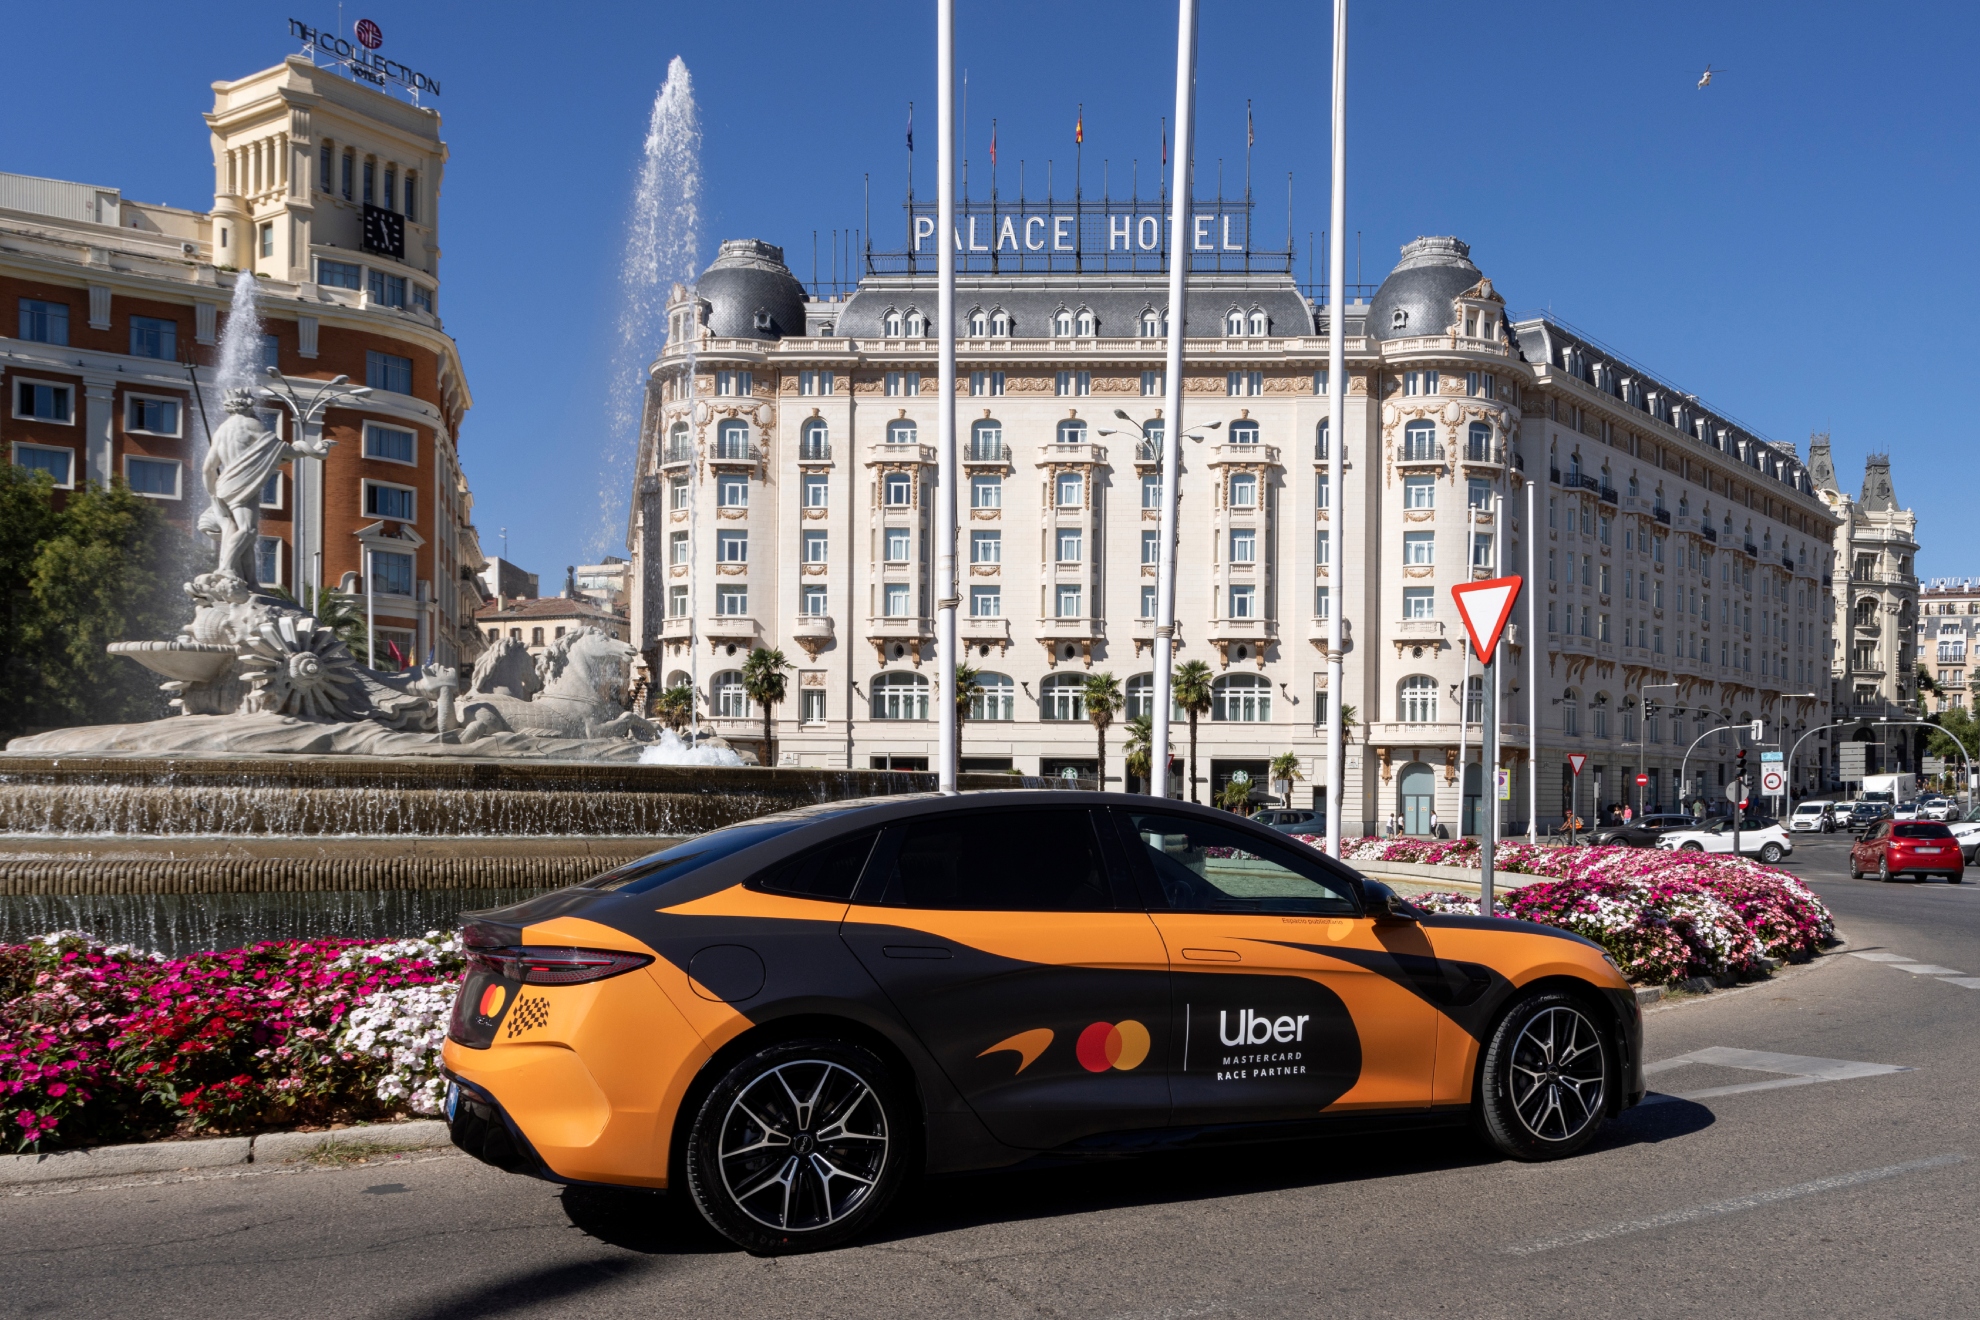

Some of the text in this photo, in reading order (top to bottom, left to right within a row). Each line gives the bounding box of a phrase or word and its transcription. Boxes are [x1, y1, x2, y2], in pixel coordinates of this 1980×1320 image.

[320, 33, 441, 97] COLLECTION
[1109, 215, 1244, 252] HOEL
[1930, 577, 1962, 587] HOTEL
[1219, 1008, 1310, 1047] Uber
[1222, 1051, 1303, 1066] MASTERCARD
[1217, 1065, 1307, 1081] RACE PARTNER
